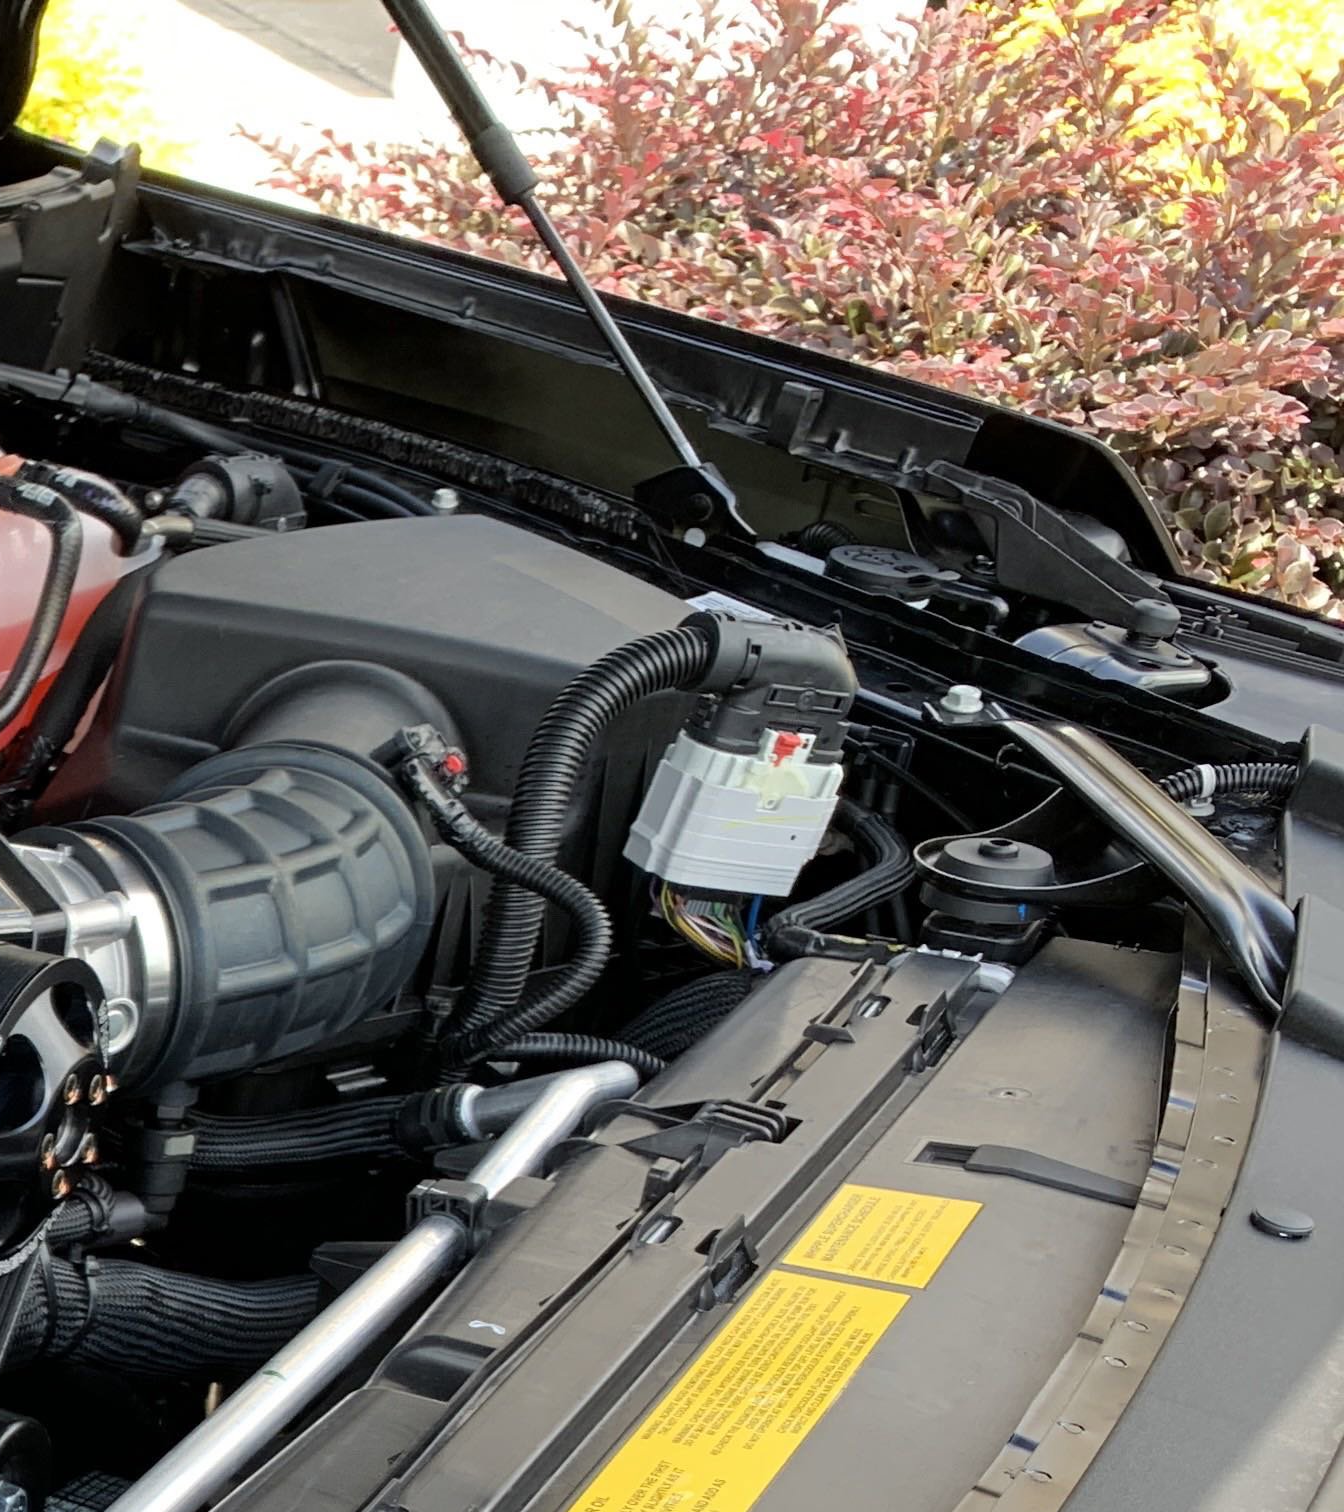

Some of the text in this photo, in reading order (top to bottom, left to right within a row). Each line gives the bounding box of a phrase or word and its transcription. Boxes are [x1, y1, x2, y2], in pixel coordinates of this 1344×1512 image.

[648, 1459, 672, 1477] FIRST
[638, 1476, 659, 1489] THE
[663, 1471, 682, 1482] AS
[708, 1477, 727, 1488] AS
[624, 1488, 649, 1506] OVER
[698, 1486, 720, 1500] ADD
[588, 1494, 610, 1508] OIL
[688, 1499, 710, 1512] AND
